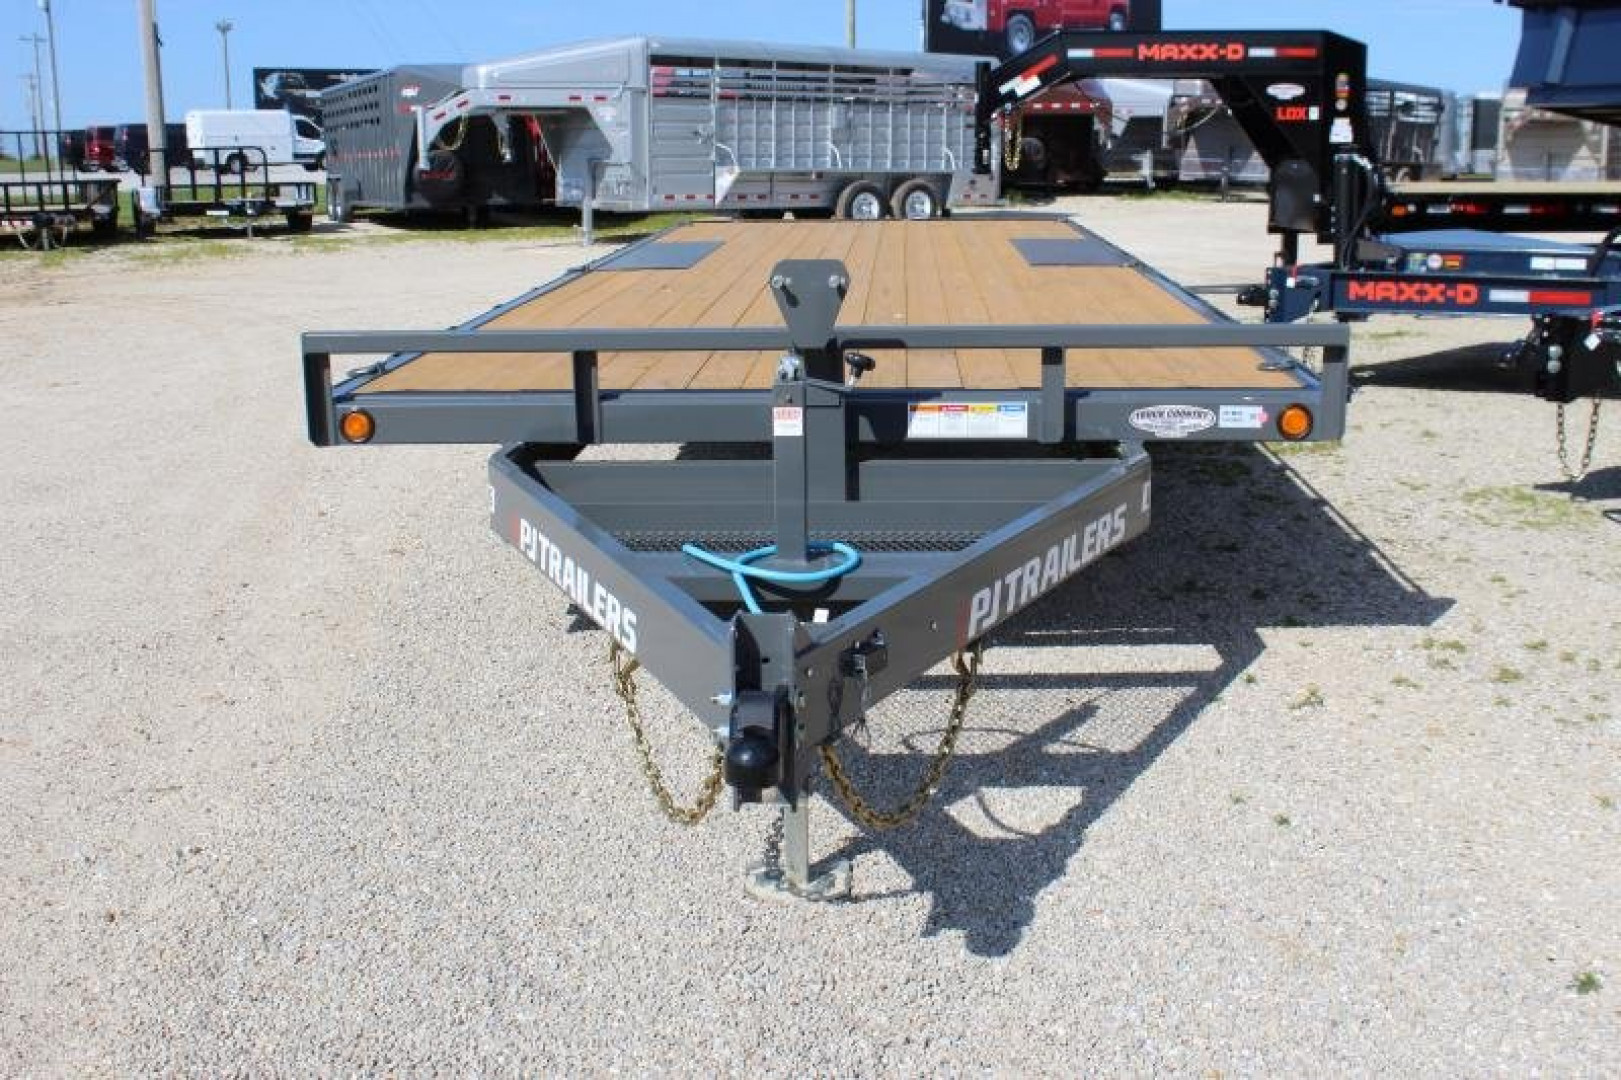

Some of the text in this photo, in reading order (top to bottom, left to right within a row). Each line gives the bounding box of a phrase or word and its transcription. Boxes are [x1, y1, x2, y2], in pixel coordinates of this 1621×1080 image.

[1137, 43, 1245, 61] MAXX-D
[1348, 281, 1479, 304] MAXX-D
[520, 518, 637, 653] PJ TRAILERS
[968, 503, 1128, 640] PJ TRAILERS
